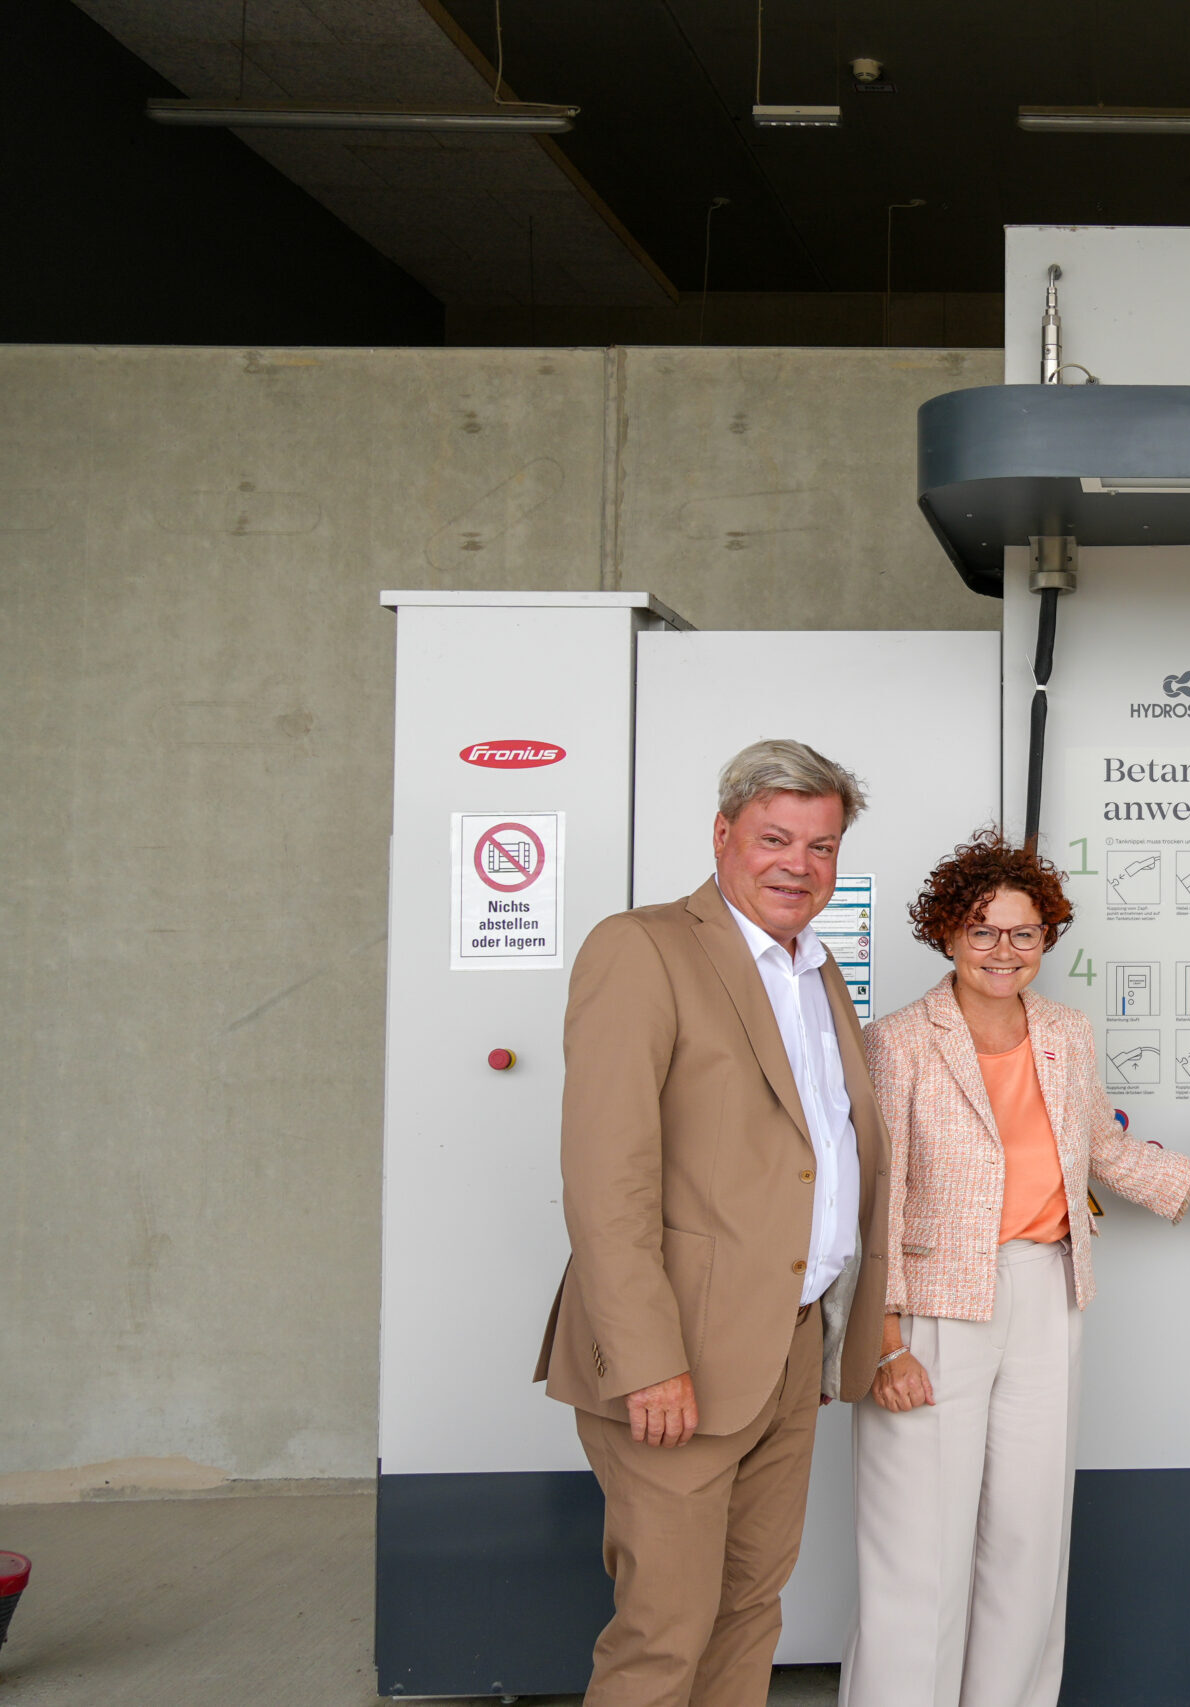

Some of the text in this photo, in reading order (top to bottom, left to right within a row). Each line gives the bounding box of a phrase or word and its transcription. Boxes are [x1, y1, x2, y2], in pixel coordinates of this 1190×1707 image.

[468, 745, 559, 761] Fronius
[1069, 837, 1099, 875] 1
[488, 900, 531, 913] Nichts
[479, 917, 539, 931] abstellen
[472, 935, 546, 950] oder lagern
[1068, 948, 1098, 987] 4
